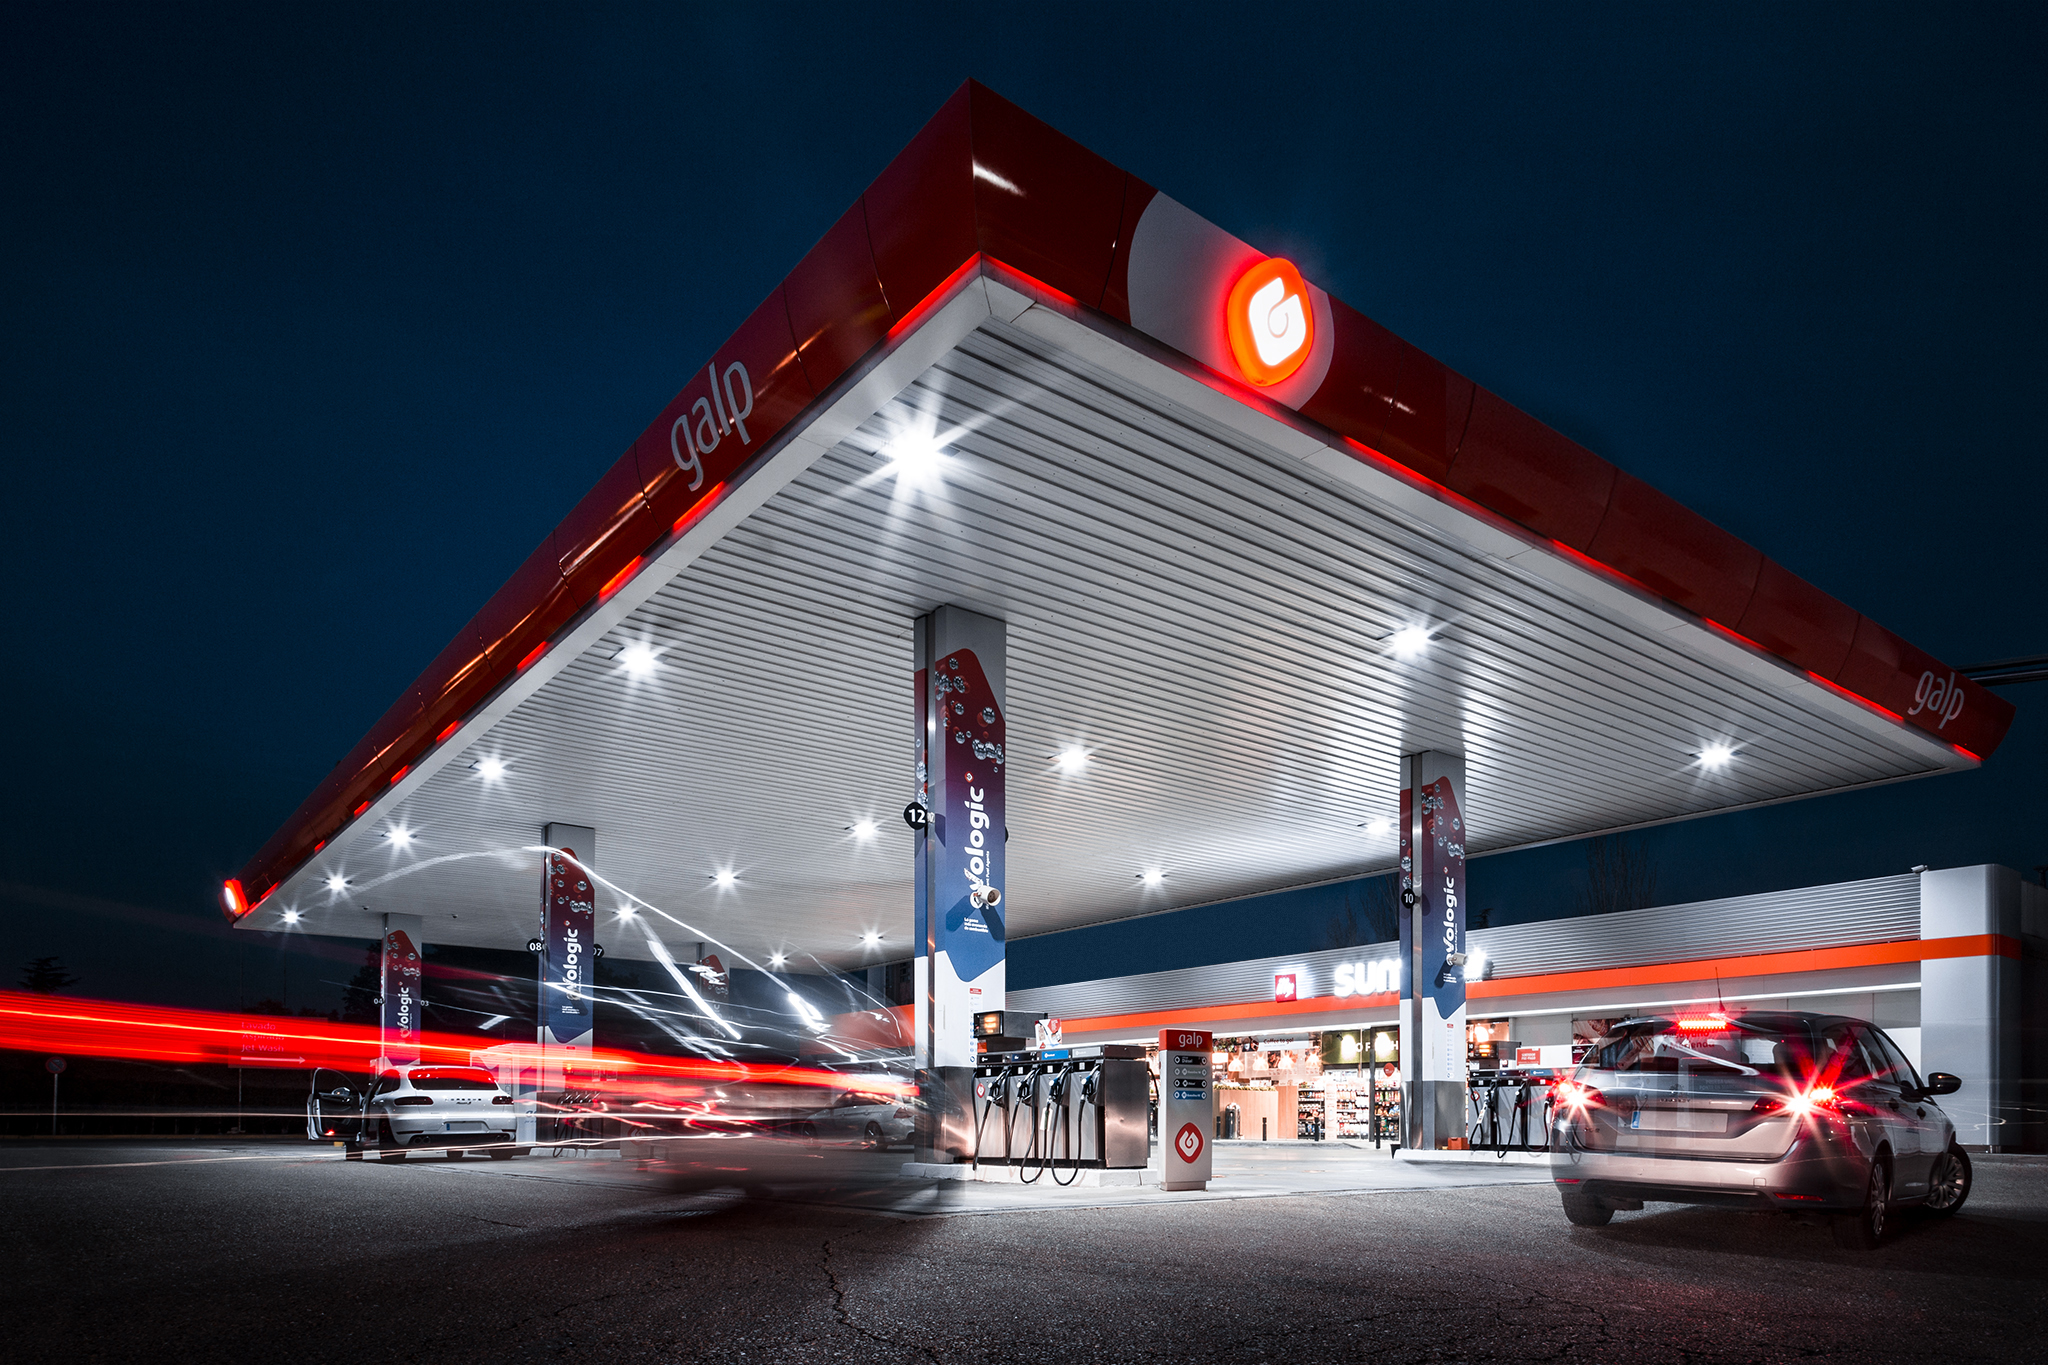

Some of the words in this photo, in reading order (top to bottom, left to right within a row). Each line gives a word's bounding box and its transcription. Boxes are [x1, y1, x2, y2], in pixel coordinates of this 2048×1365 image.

[670, 360, 754, 493] galp
[1906, 670, 1965, 730] galp
[908, 808, 926, 824] 12
[1404, 893, 1414, 904] 10
[529, 942, 542, 951] 08
[241, 1021, 276, 1031] Lavado
[1178, 1032, 1203, 1048] galp
[241, 1043, 255, 1052] Jet
[258, 1044, 284, 1052] Wash
